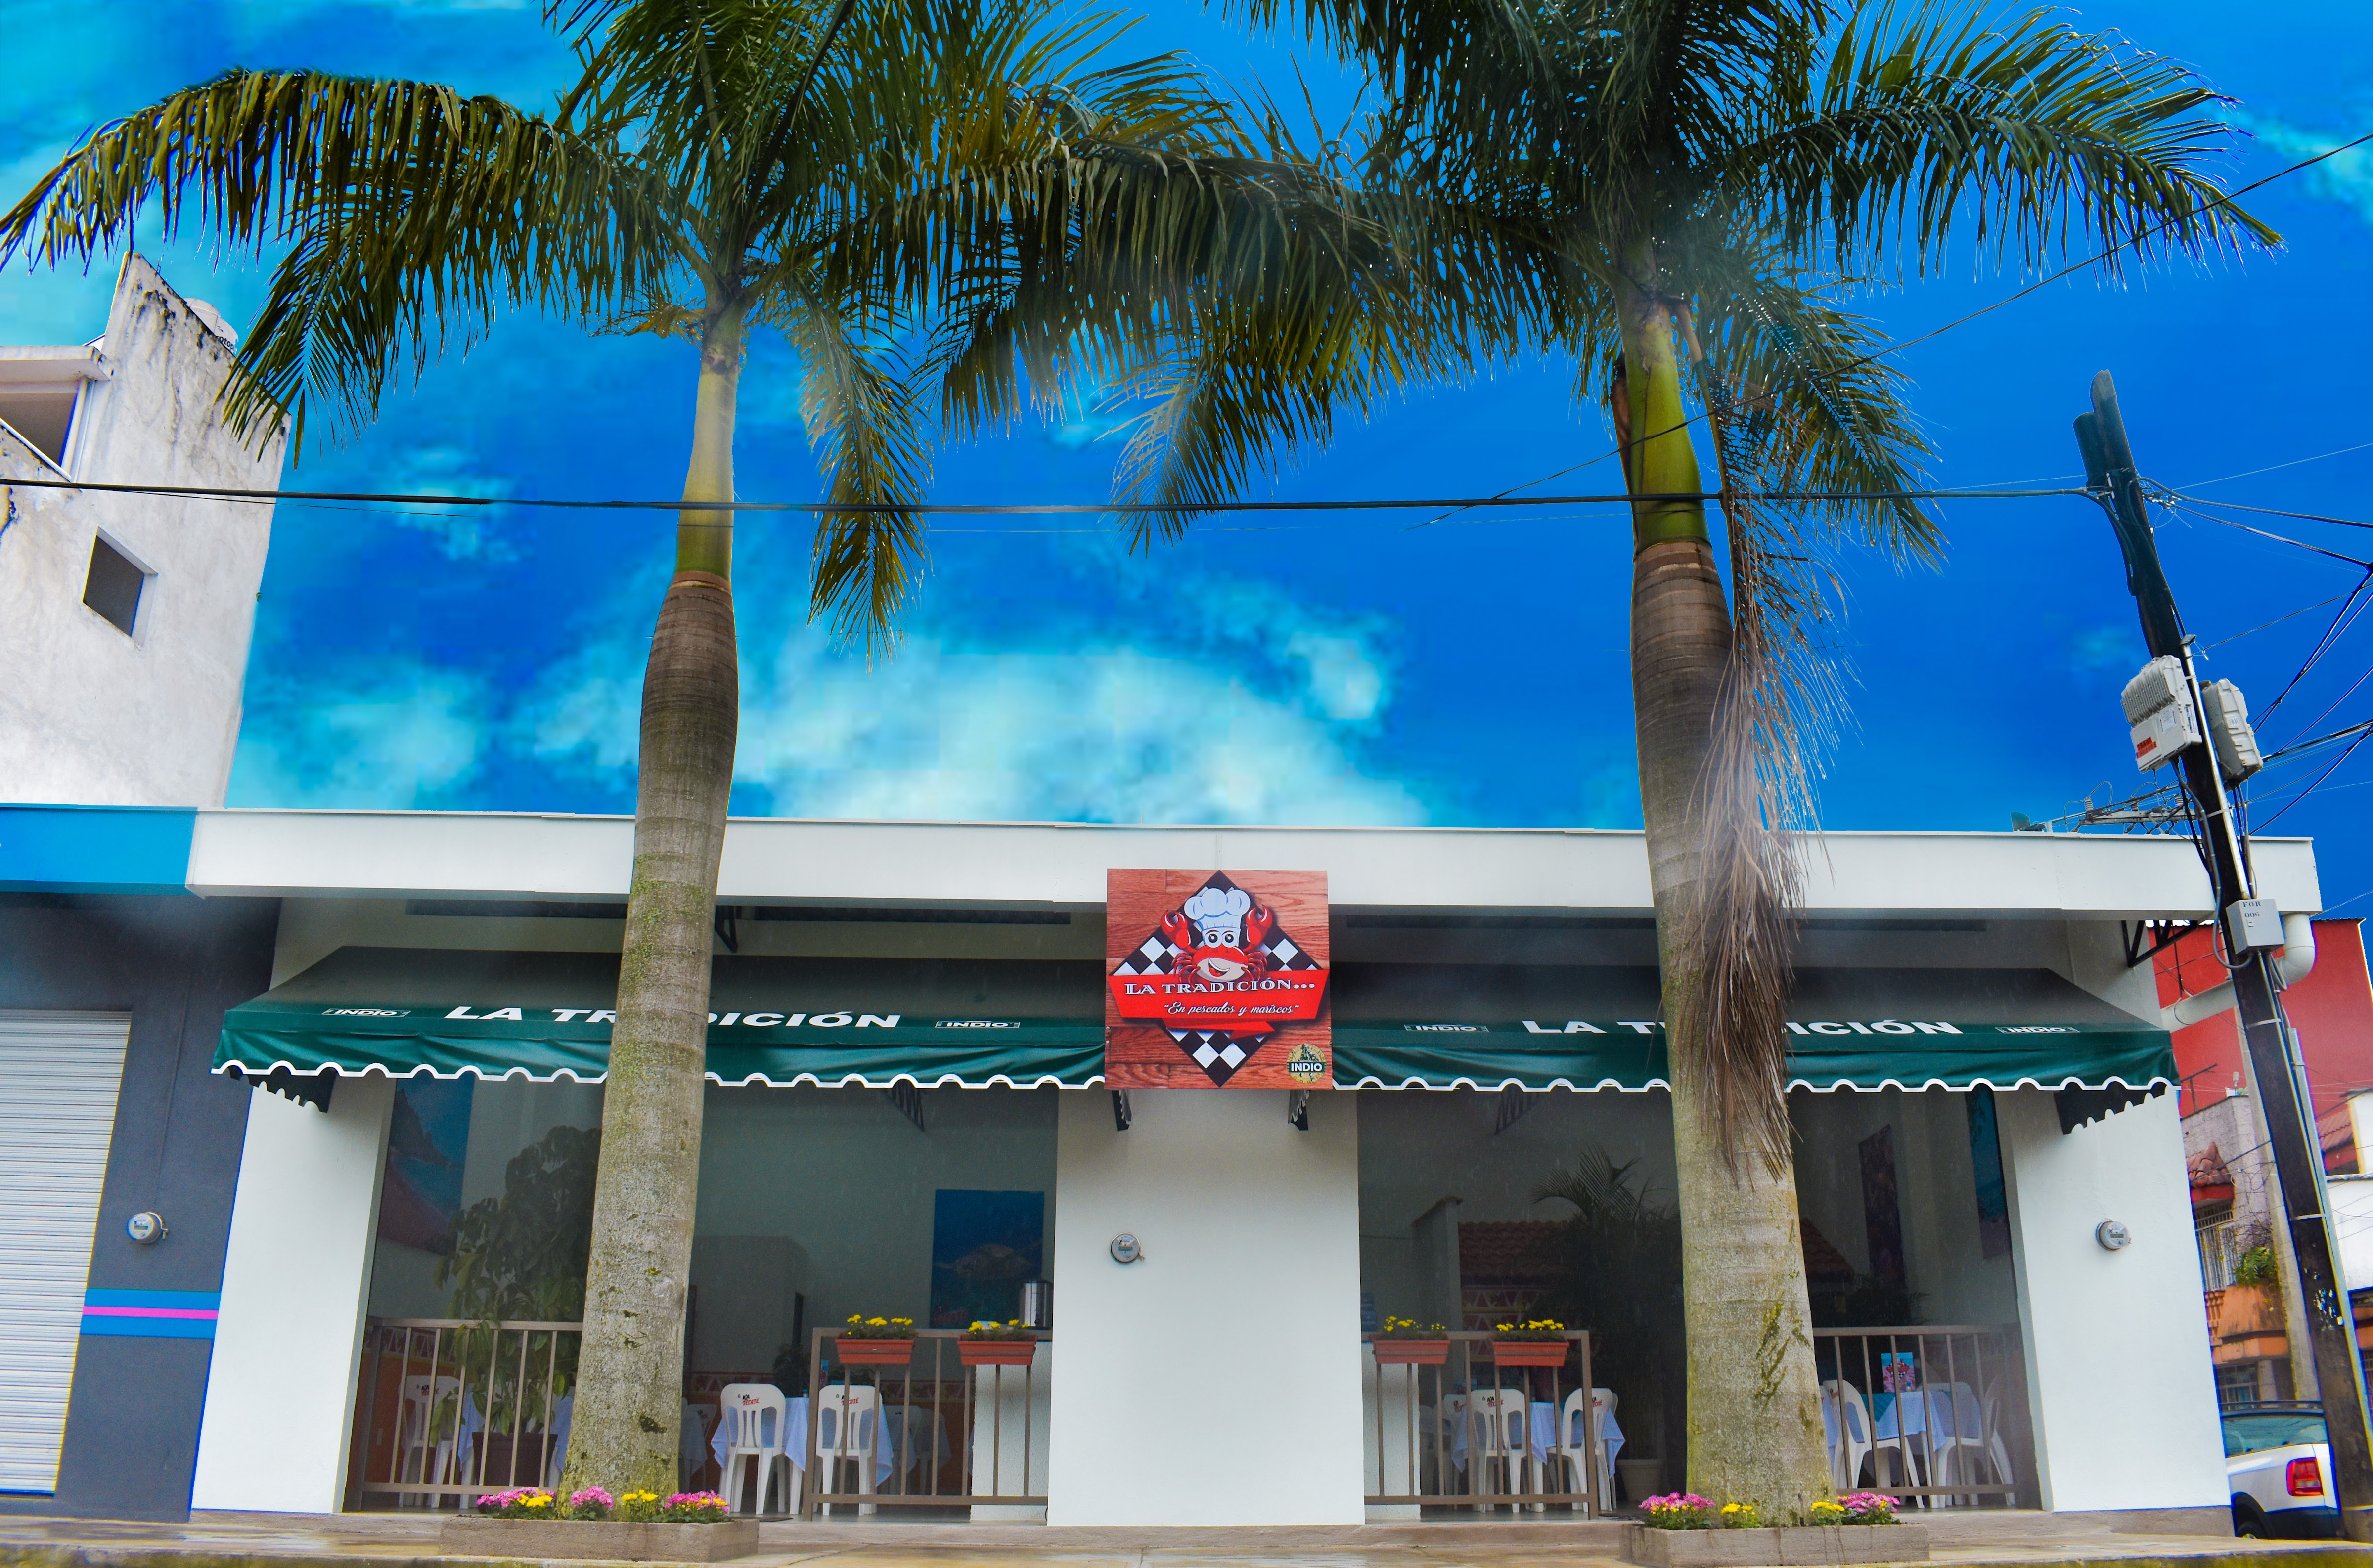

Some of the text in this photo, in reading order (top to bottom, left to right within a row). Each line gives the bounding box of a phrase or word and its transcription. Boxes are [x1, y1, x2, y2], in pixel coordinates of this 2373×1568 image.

[1124, 977, 1315, 995] LA TRADICIÓN...
[444, 1006, 901, 1028] LA TRICIÓN
[1187, 1002, 1236, 1015] pescados
[1237, 1006, 1247, 1016] y
[1522, 1019, 1964, 1035] LA TICIÓN
[1291, 1062, 1322, 1072] INDIO
